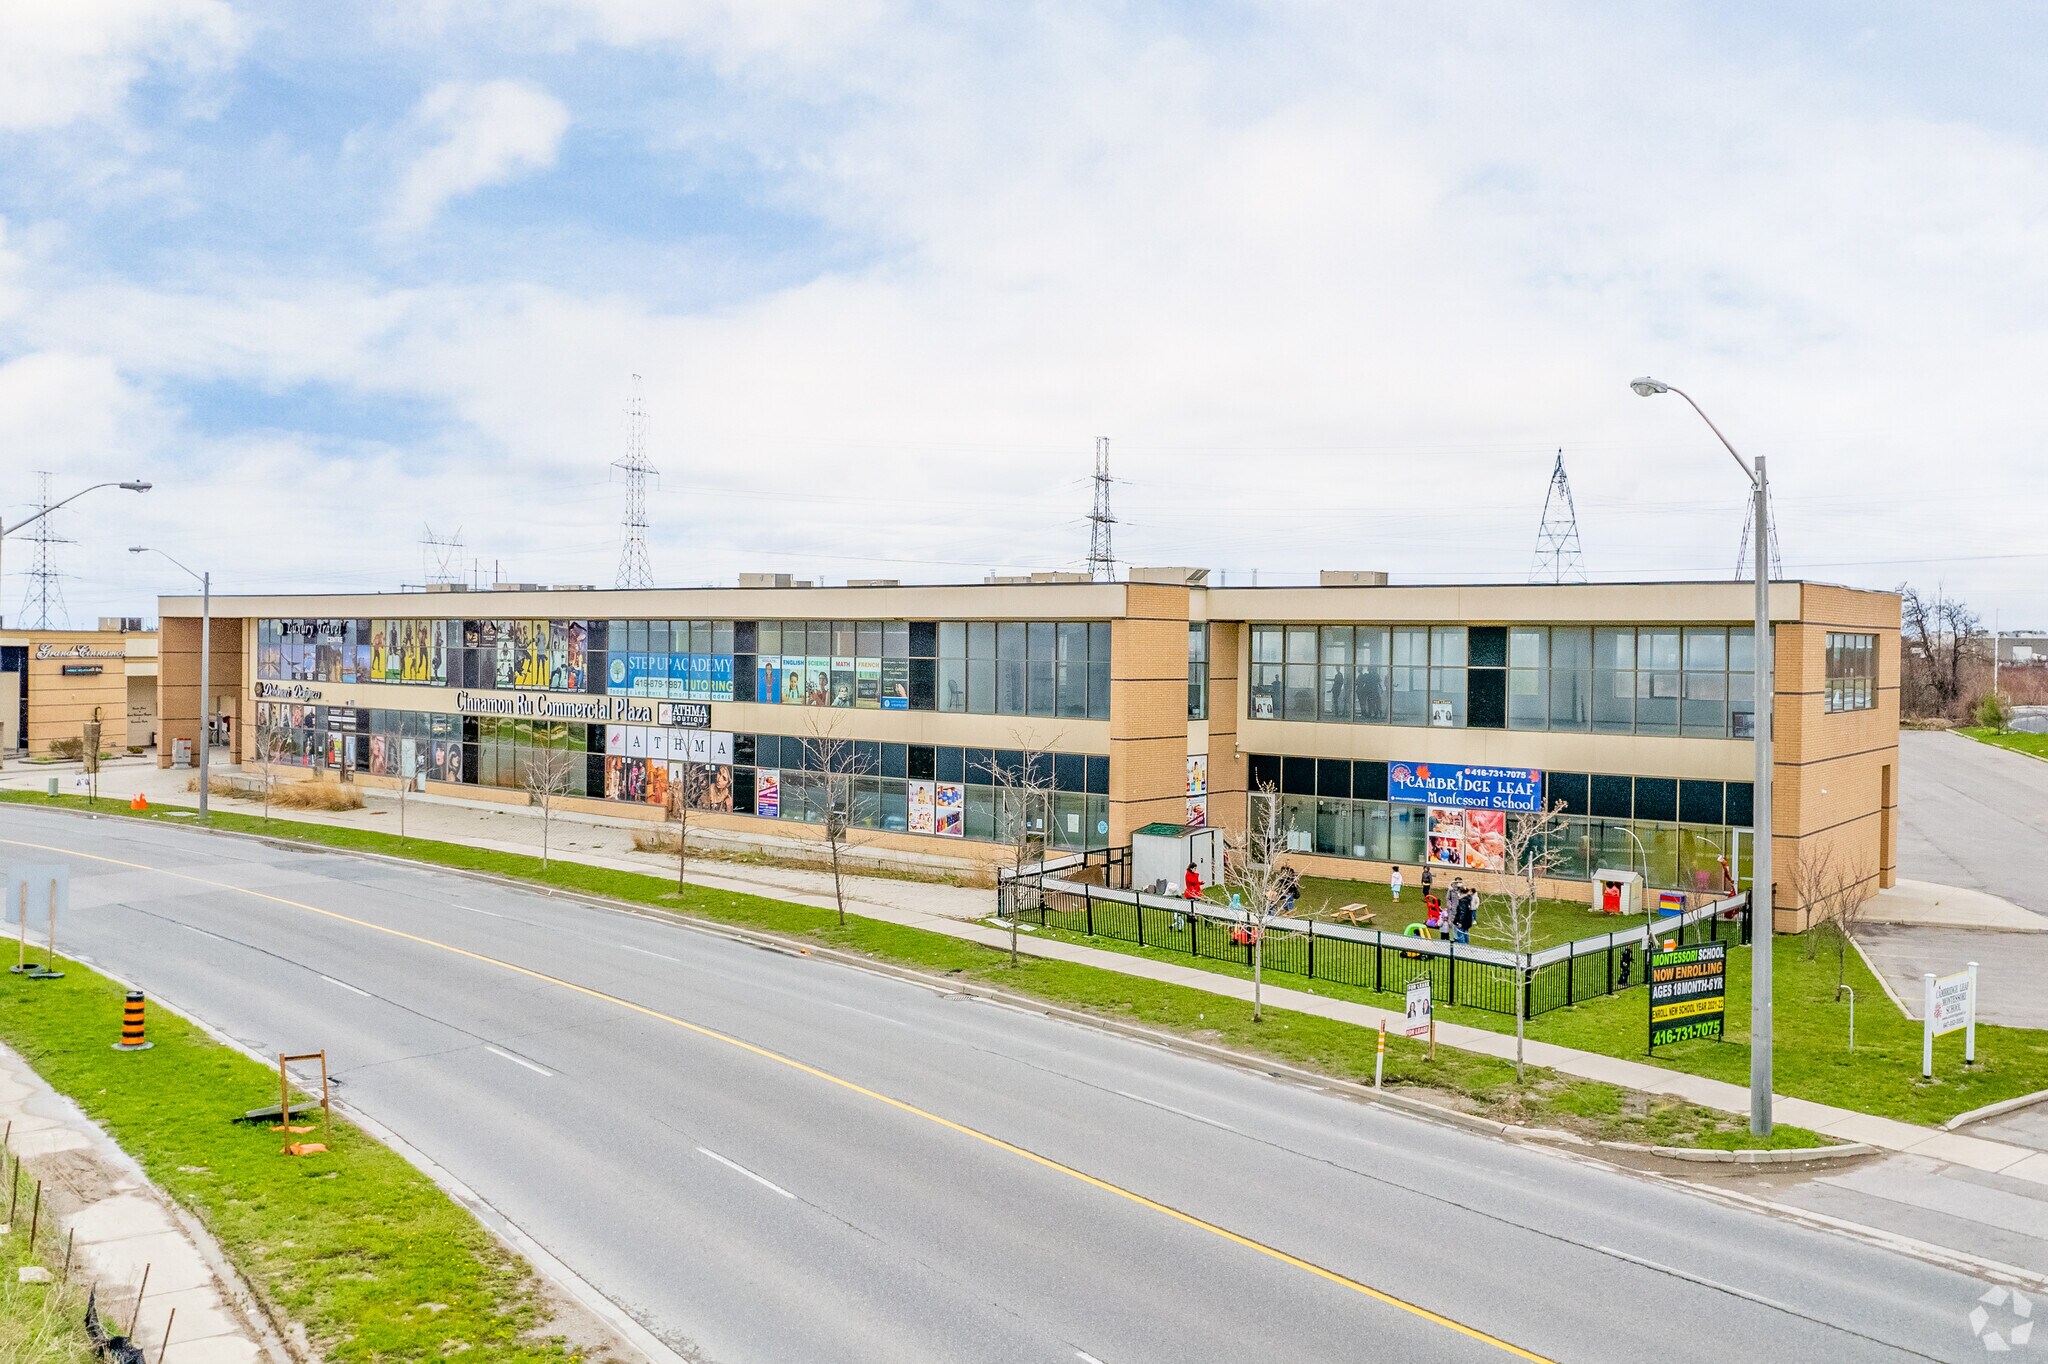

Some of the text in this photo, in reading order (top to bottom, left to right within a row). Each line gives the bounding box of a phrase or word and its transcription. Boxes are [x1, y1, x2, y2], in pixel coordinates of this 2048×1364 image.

[36, 643, 126, 660] Grand Cinnamon
[628, 656, 655, 671] STEP
[657, 657, 671, 671] UP
[673, 658, 733, 674] ACADEMY
[783, 659, 805, 667] ENGLISH
[836, 660, 850, 668] MATH
[685, 679, 734, 692] TUTORING
[456, 690, 652, 722] Cinnamon Ru Commercial Plaza
[672, 704, 708, 717] ATHMA
[673, 715, 708, 723] BOUTIQUE
[1471, 768, 1527, 780] 416-731-7075
[1407, 770, 1535, 796] CAMBRIDGE LEAF
[1427, 792, 1489, 808] Montessori
[1493, 792, 1535, 811] School
[1653, 946, 1724, 967] MONTESSORI SCHOOL
[1653, 961, 1723, 982] NOW ENROLLING
[1652, 984, 1672, 999] AGES
[1679, 1003, 1695, 1015] SCHOOL
[1653, 1021, 1720, 1046] 416-731-7075
